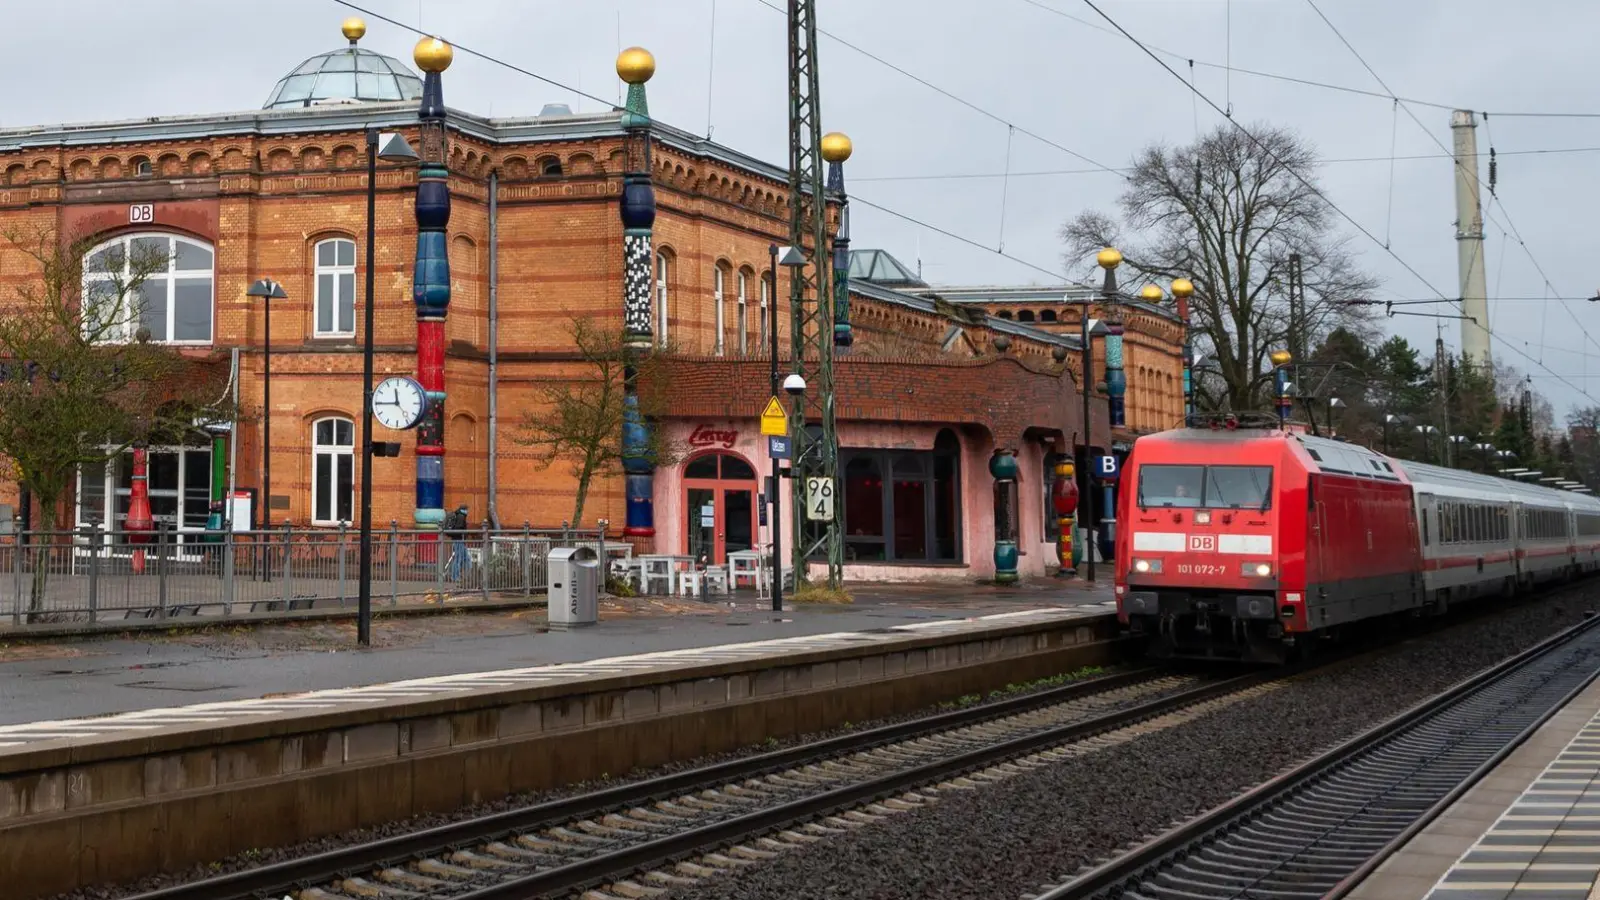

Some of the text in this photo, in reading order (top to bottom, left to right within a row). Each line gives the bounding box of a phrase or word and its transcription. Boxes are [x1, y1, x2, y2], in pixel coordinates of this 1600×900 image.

[132, 206, 151, 220] DB
[1103, 456, 1116, 472] B
[808, 480, 832, 497] 96
[814, 499, 826, 516] 4
[1191, 537, 1213, 549] DB
[1177, 564, 1226, 575] 101 072-7
[570, 580, 578, 615] Abfall
